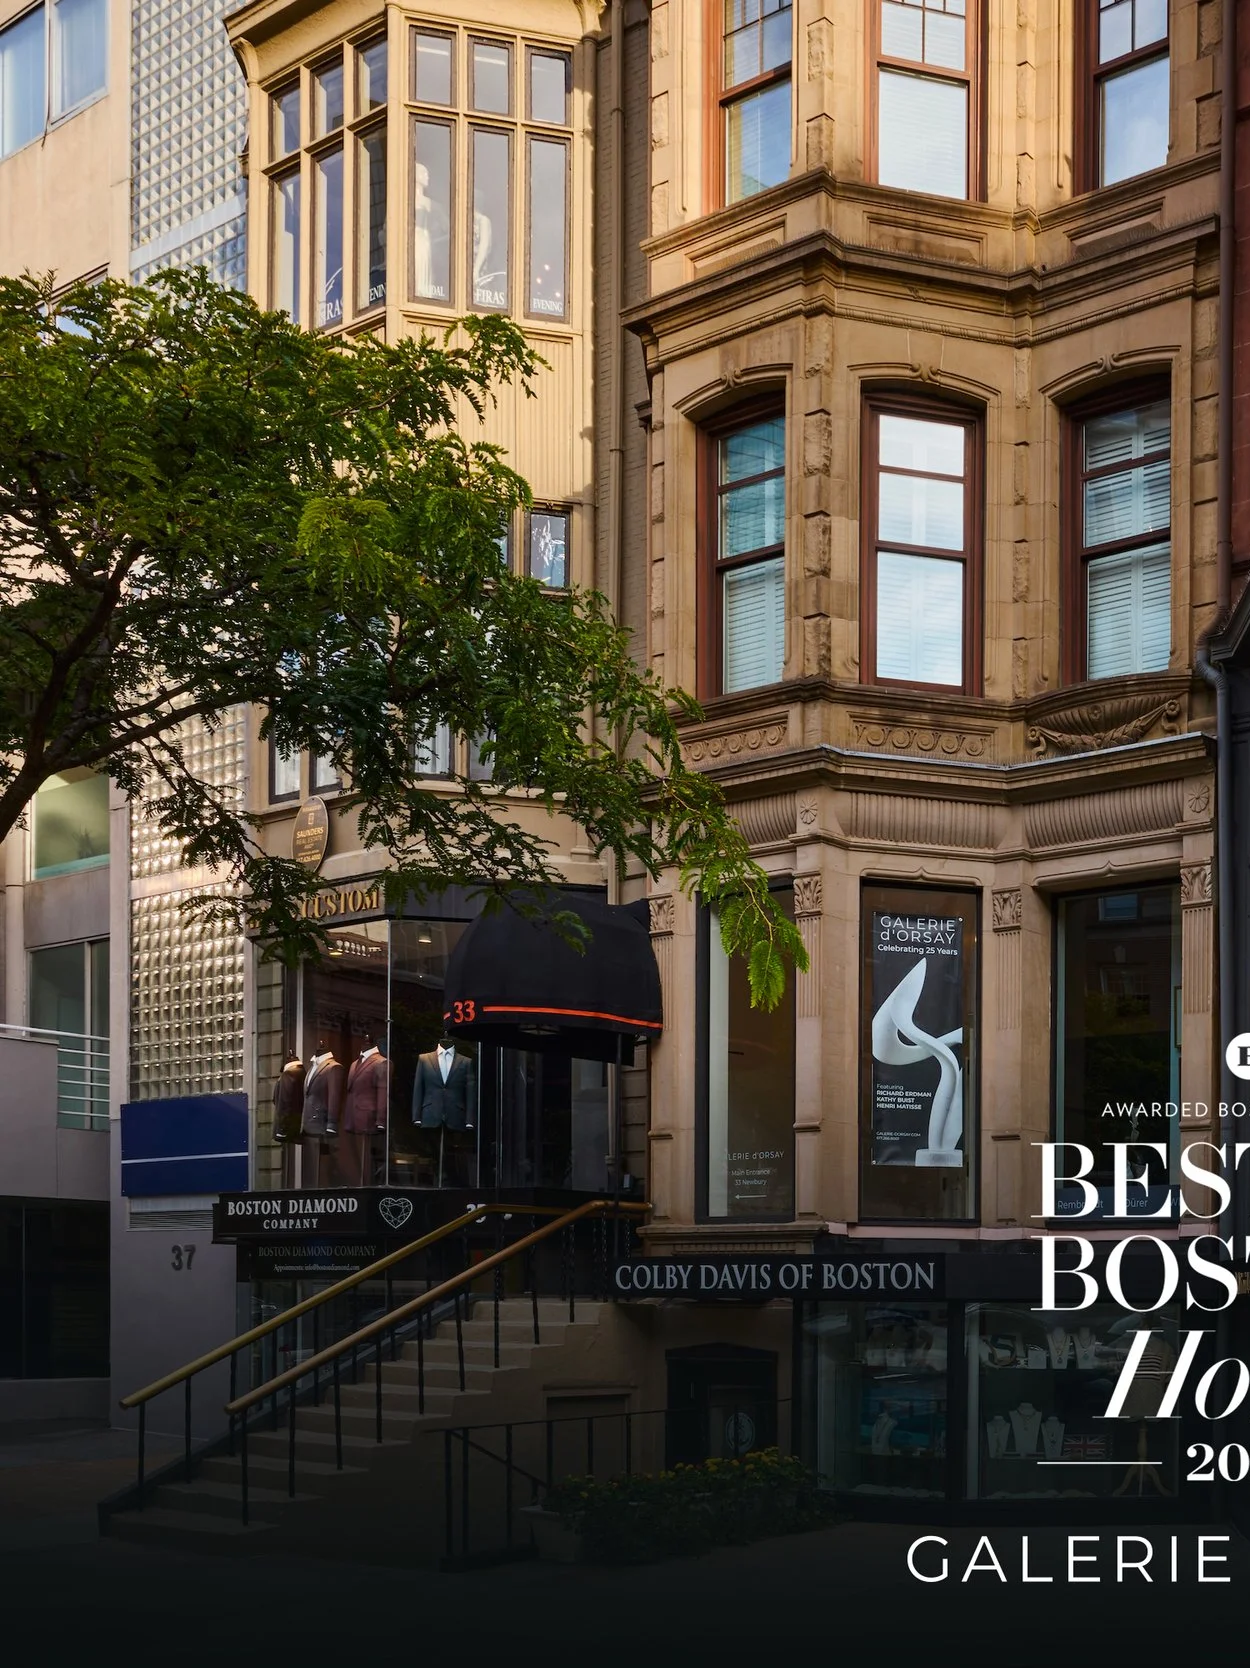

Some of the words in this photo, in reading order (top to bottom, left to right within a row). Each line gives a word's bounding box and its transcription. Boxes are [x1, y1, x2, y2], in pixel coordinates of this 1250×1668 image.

[476, 288, 505, 305] FIRAS
[533, 298, 562, 312] EVENING
[296, 827, 324, 839] SAUNDERS
[301, 889, 378, 919] CUSTOM
[880, 915, 956, 932] GALERIE
[880, 928, 955, 944] d'ORSAY
[877, 943, 924, 955] Celebrating
[926, 946, 936, 954] 25
[937, 947, 958, 956] Years
[453, 1000, 476, 1024] 33
[876, 1083, 904, 1091] Featuring
[728, 1151, 750, 1161] LERIE
[752, 1149, 785, 1160] d'ORSAY
[746, 1168, 771, 1176] Entrance
[743, 1178, 767, 1187] Newbury
[227, 1200, 281, 1215] BOSTON
[288, 1198, 358, 1214] DIAMOND
[263, 1218, 319, 1230] COMPANY
[171, 1244, 196, 1271] 37
[258, 1245, 291, 1257] BOSTON
[292, 1245, 333, 1257] DIAMOND
[334, 1245, 376, 1256] COMPANY
[615, 1264, 693, 1290] COLBY
[700, 1263, 771, 1290] DAVIS
[778, 1262, 813, 1290] OF
[822, 1261, 935, 1290] BOSTON
